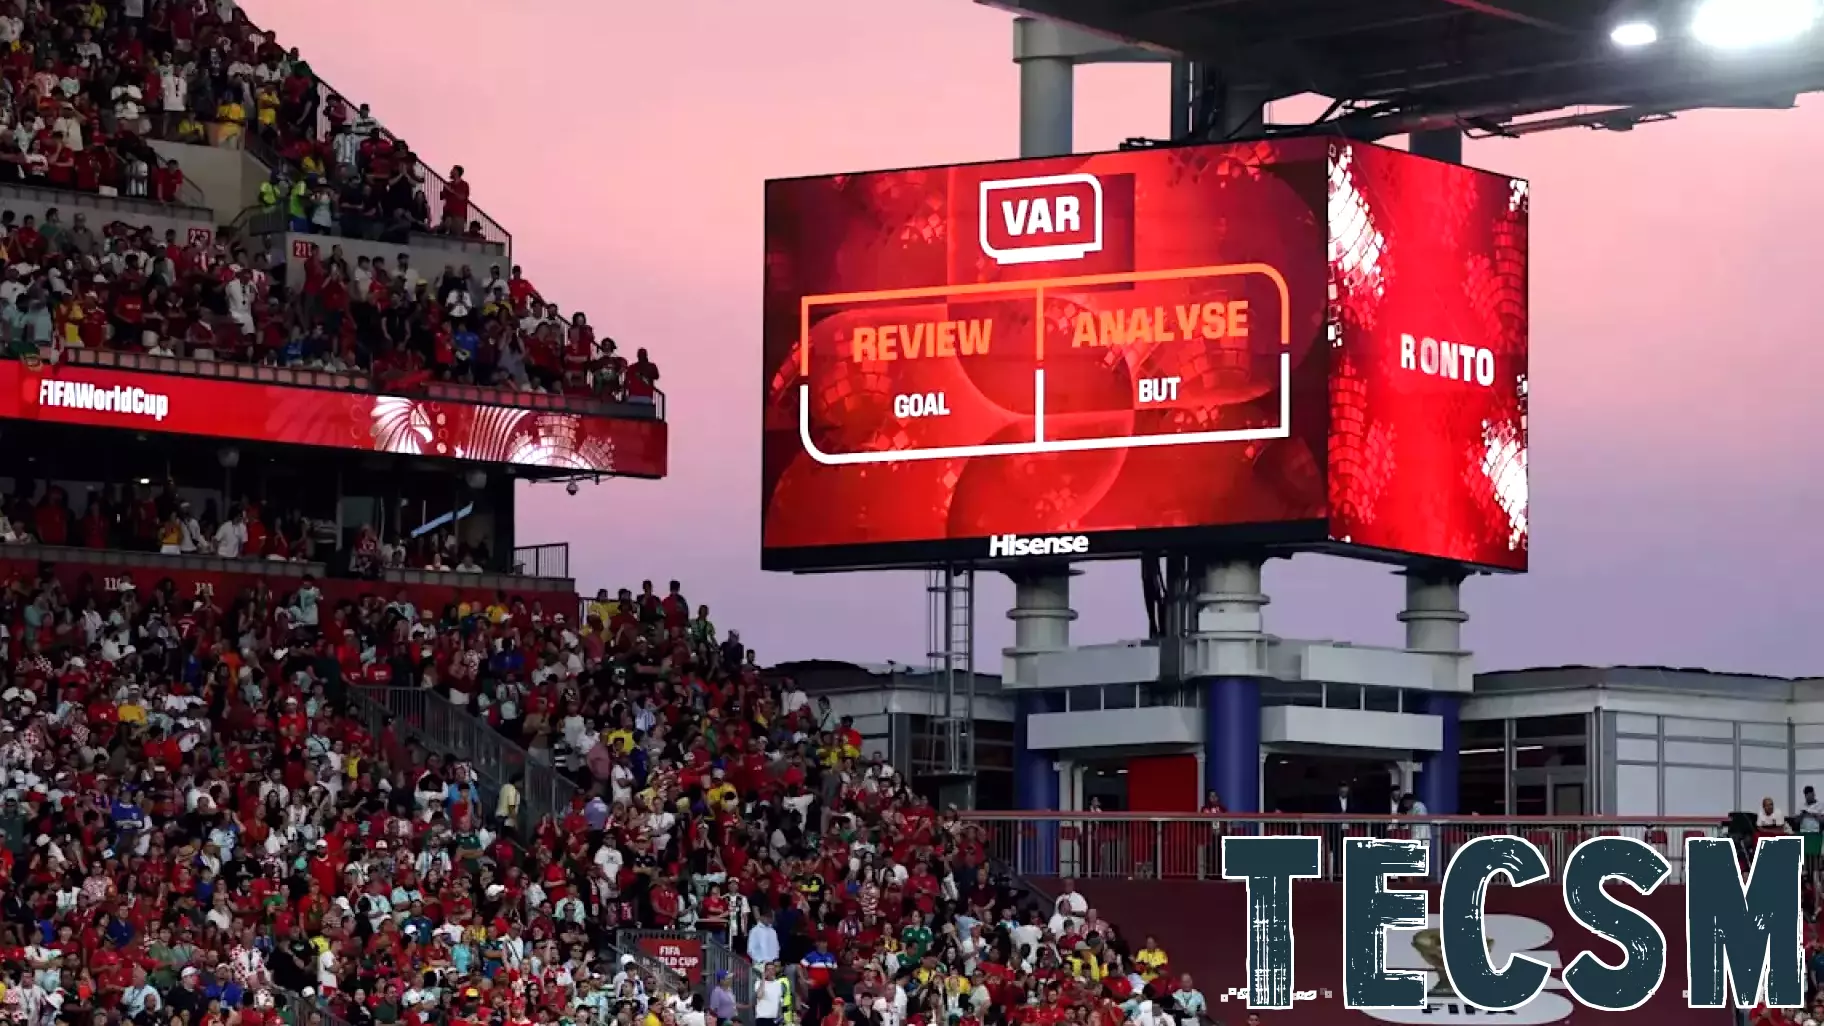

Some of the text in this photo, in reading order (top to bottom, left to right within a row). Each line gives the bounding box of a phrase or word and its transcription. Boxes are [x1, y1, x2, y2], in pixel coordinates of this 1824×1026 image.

[1002, 195, 1080, 236] VAR
[853, 318, 993, 362] REVIEW
[1071, 301, 1249, 347] ANALYSE
[1401, 333, 1494, 387] RONTO
[39, 379, 169, 421] FIFAWorldCup
[894, 392, 950, 418] GOAL
[1138, 376, 1181, 403] BUT
[989, 534, 1089, 557] Hisense
[659, 945, 681, 956] FIFA
